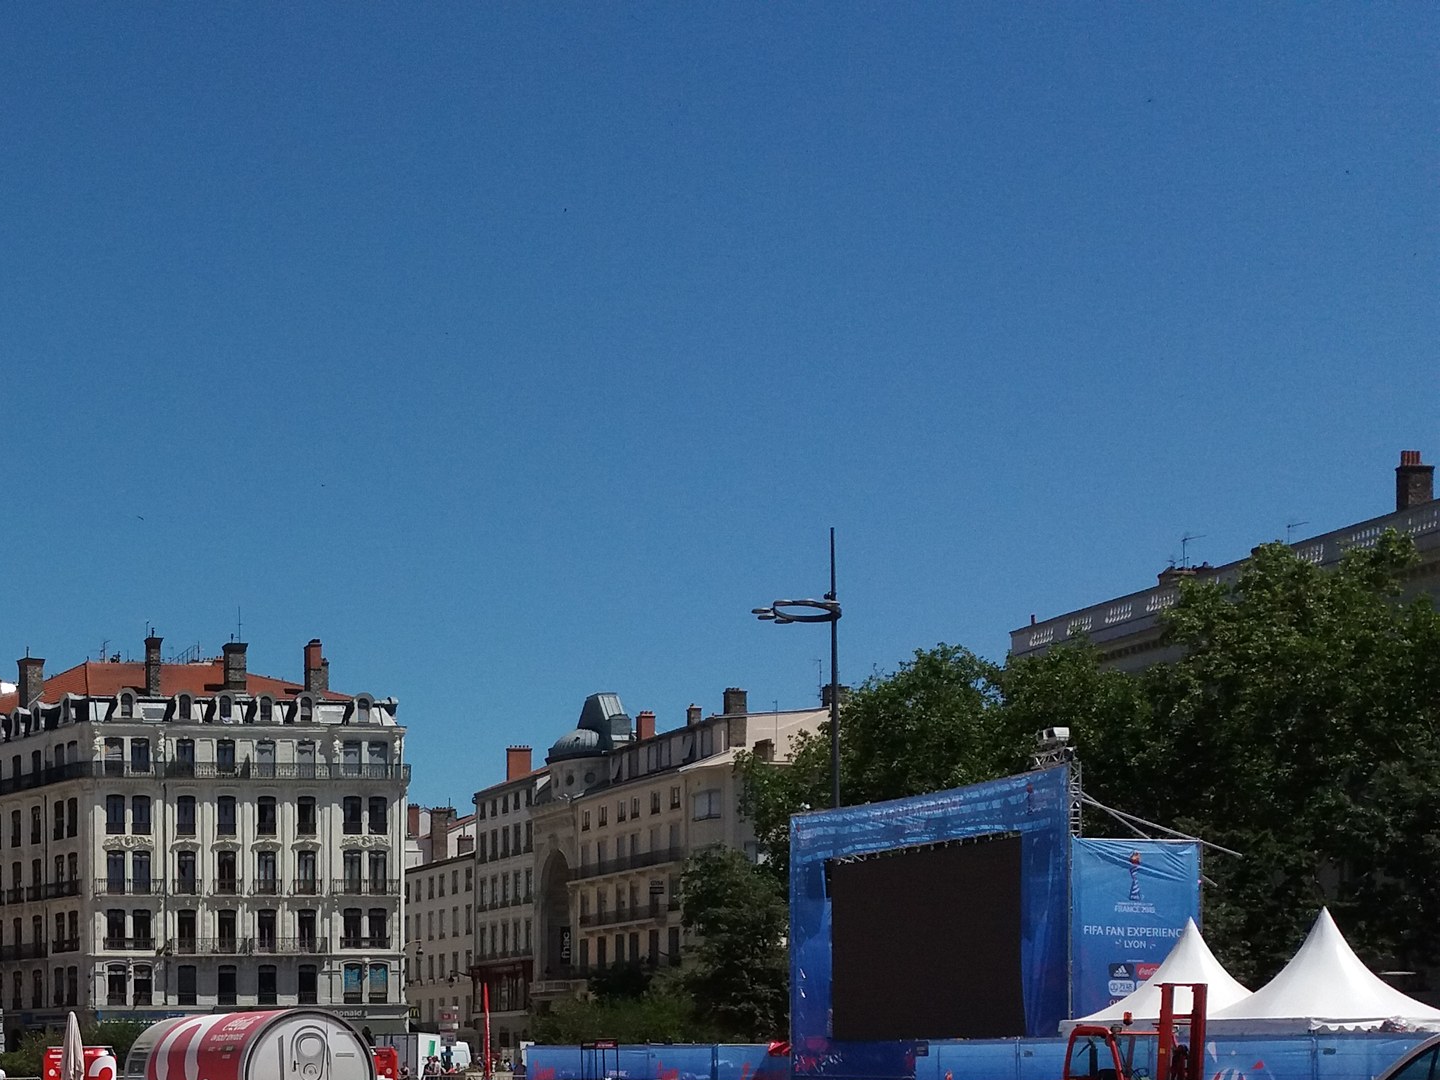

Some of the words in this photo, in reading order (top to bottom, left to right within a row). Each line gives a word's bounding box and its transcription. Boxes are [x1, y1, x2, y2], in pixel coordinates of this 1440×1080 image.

[1115, 905, 1140, 913] FRANCE
[1083, 925, 1103, 936] FIFA
[1105, 926, 1125, 937] FAN
[1127, 926, 1184, 938] EXPERIENC
[561, 931, 571, 960] fnac
[1124, 940, 1147, 949] LYON
